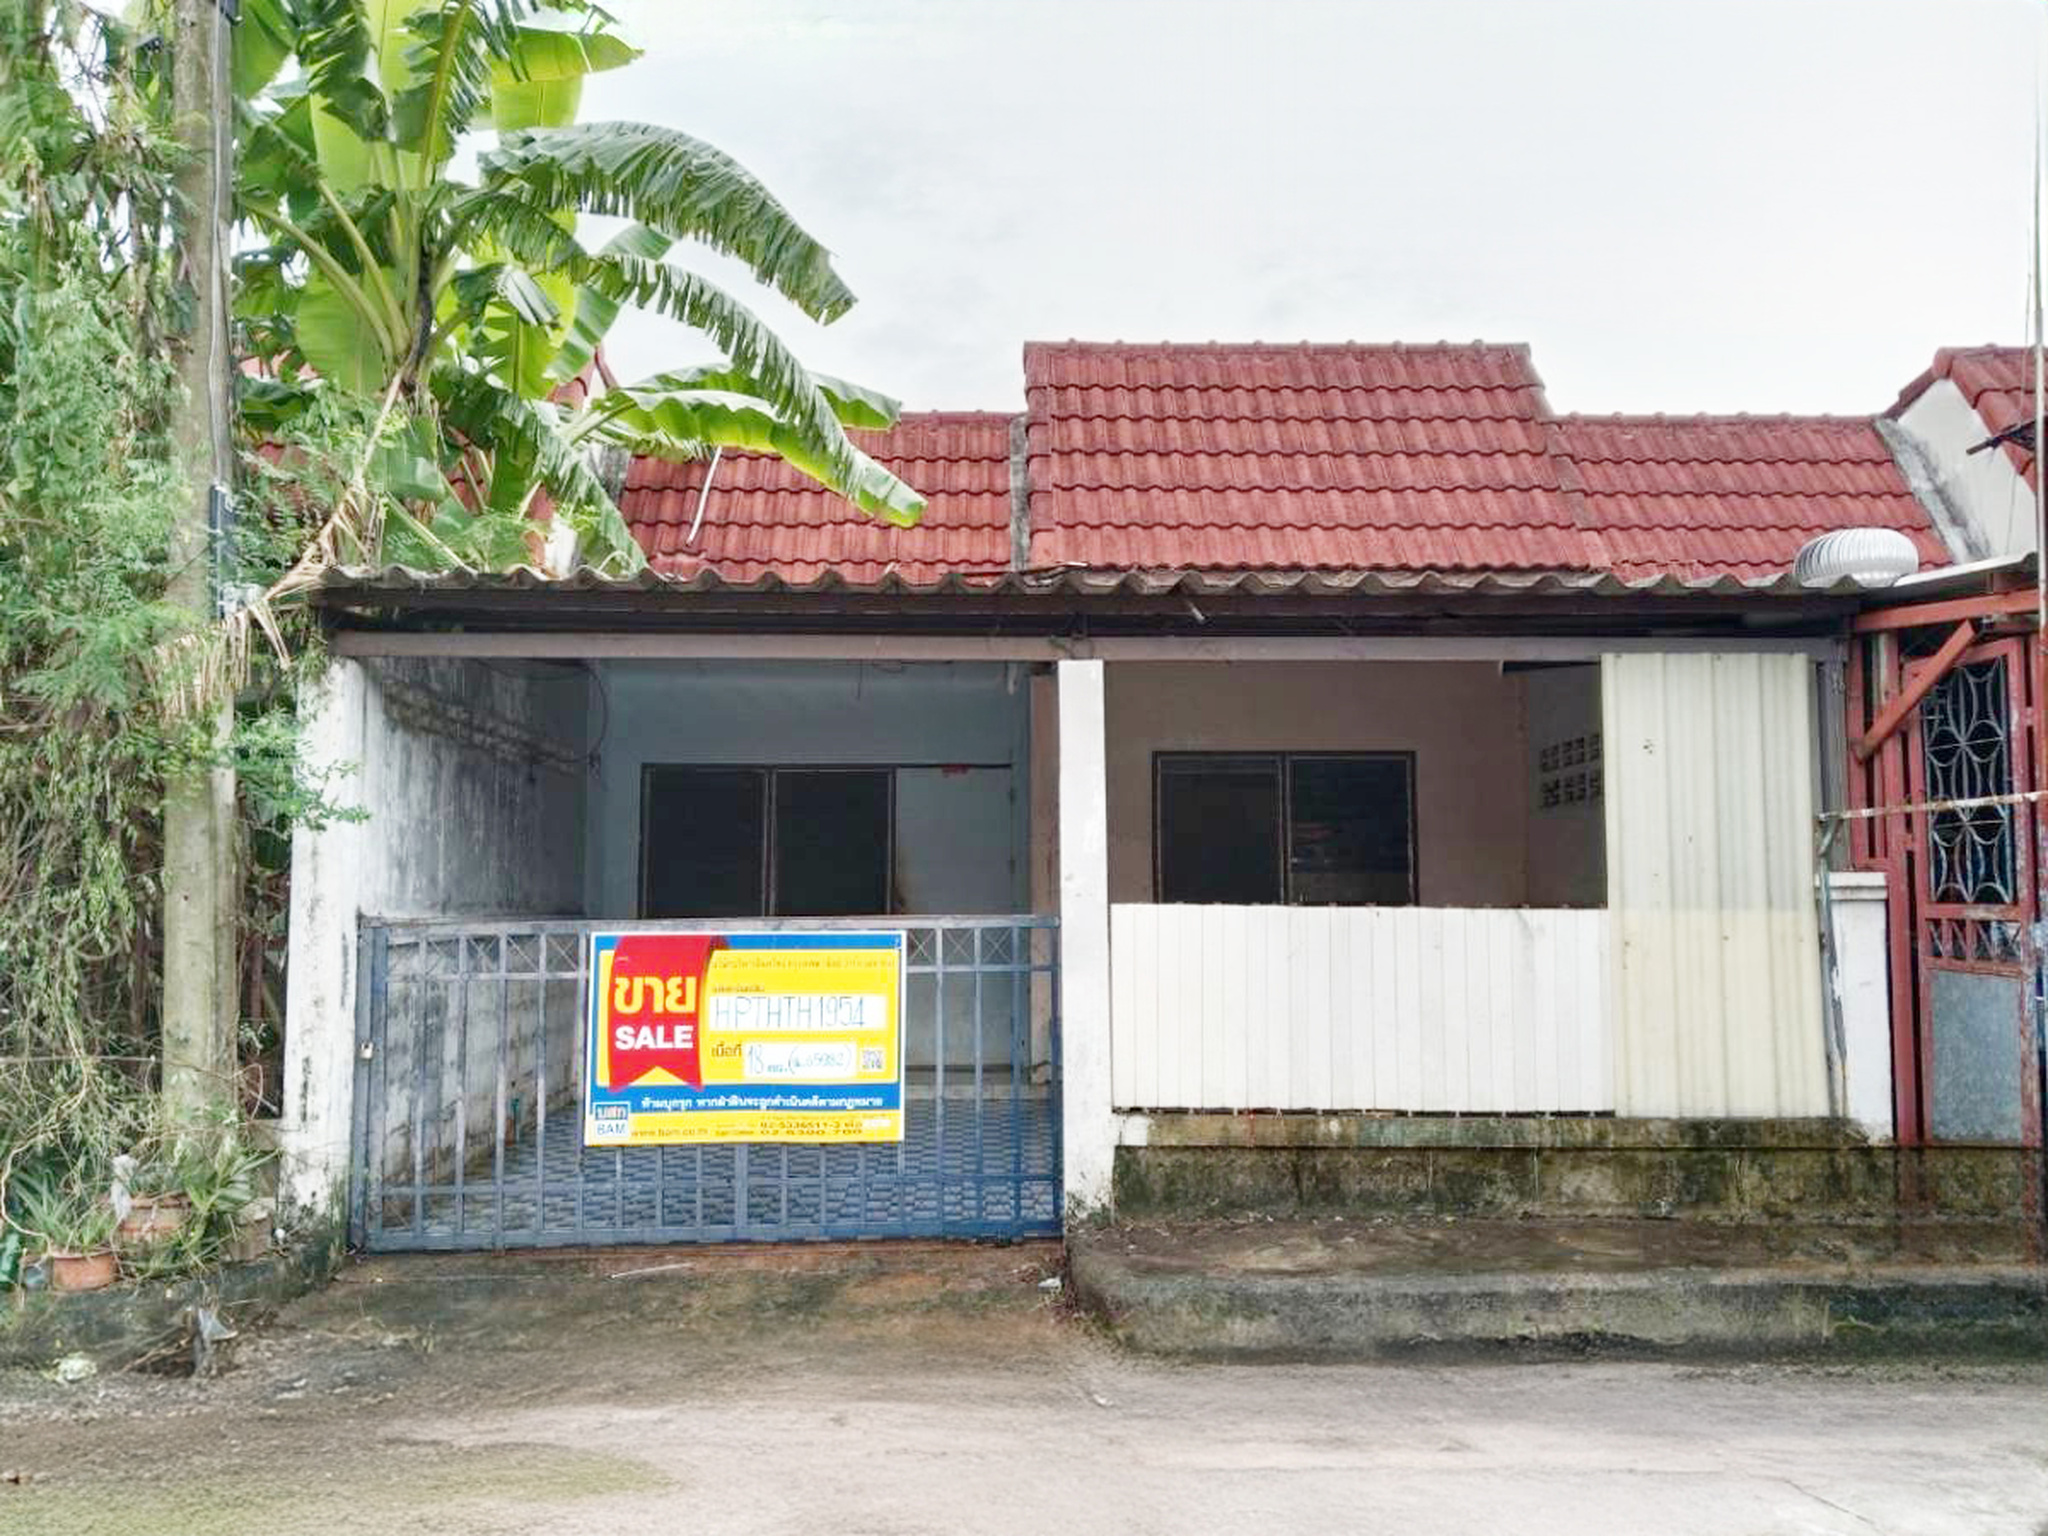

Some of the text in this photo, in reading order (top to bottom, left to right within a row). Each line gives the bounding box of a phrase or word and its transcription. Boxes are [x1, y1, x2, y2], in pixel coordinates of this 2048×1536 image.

[614, 976, 697, 1014] ขาย
[715, 995, 866, 1028] HPTHTH1954
[615, 1025, 694, 1050] SALE
[596, 1122, 626, 1136] BAM
